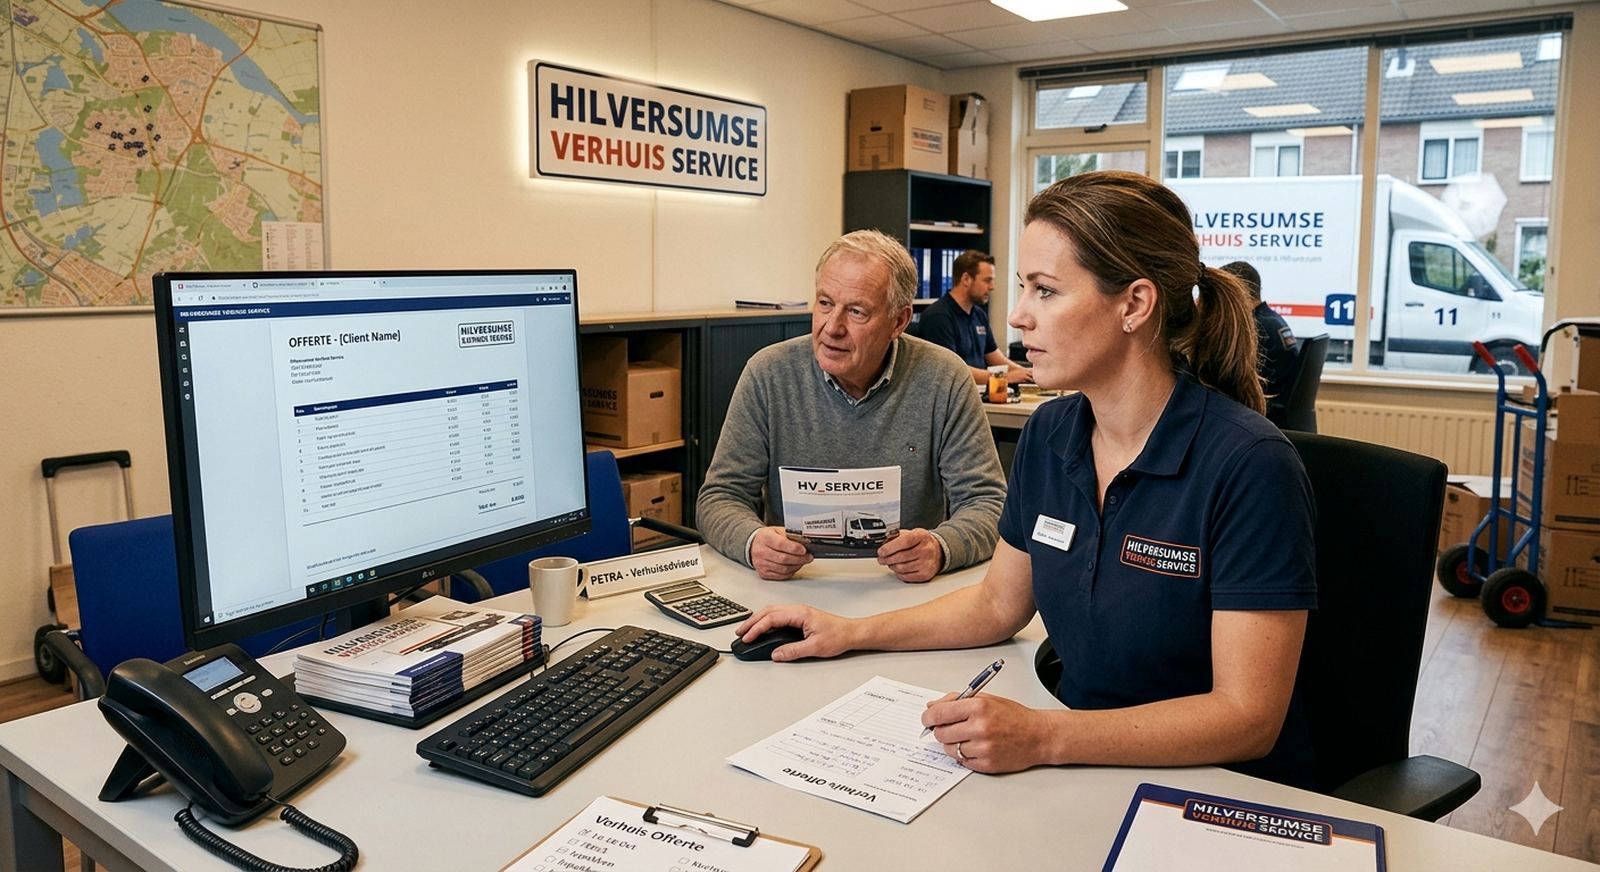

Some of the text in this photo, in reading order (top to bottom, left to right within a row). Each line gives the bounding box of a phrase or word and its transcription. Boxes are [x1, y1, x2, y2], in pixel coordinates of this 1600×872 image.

[551, 83, 758, 148] HILVERSUMSE
[551, 131, 758, 181] VERHUIS SERVICE
[1194, 212, 1324, 228] LVERSUMSE
[1198, 234, 1323, 247] HUIS SERVICE
[1329, 299, 1355, 320] 11
[1434, 307, 1458, 326] 11
[288, 335, 332, 348] OFFERTE
[339, 331, 370, 346] [Client
[371, 329, 401, 342] Name]
[798, 480, 884, 493] HV_SERVICE
[590, 571, 624, 585] PETRA
